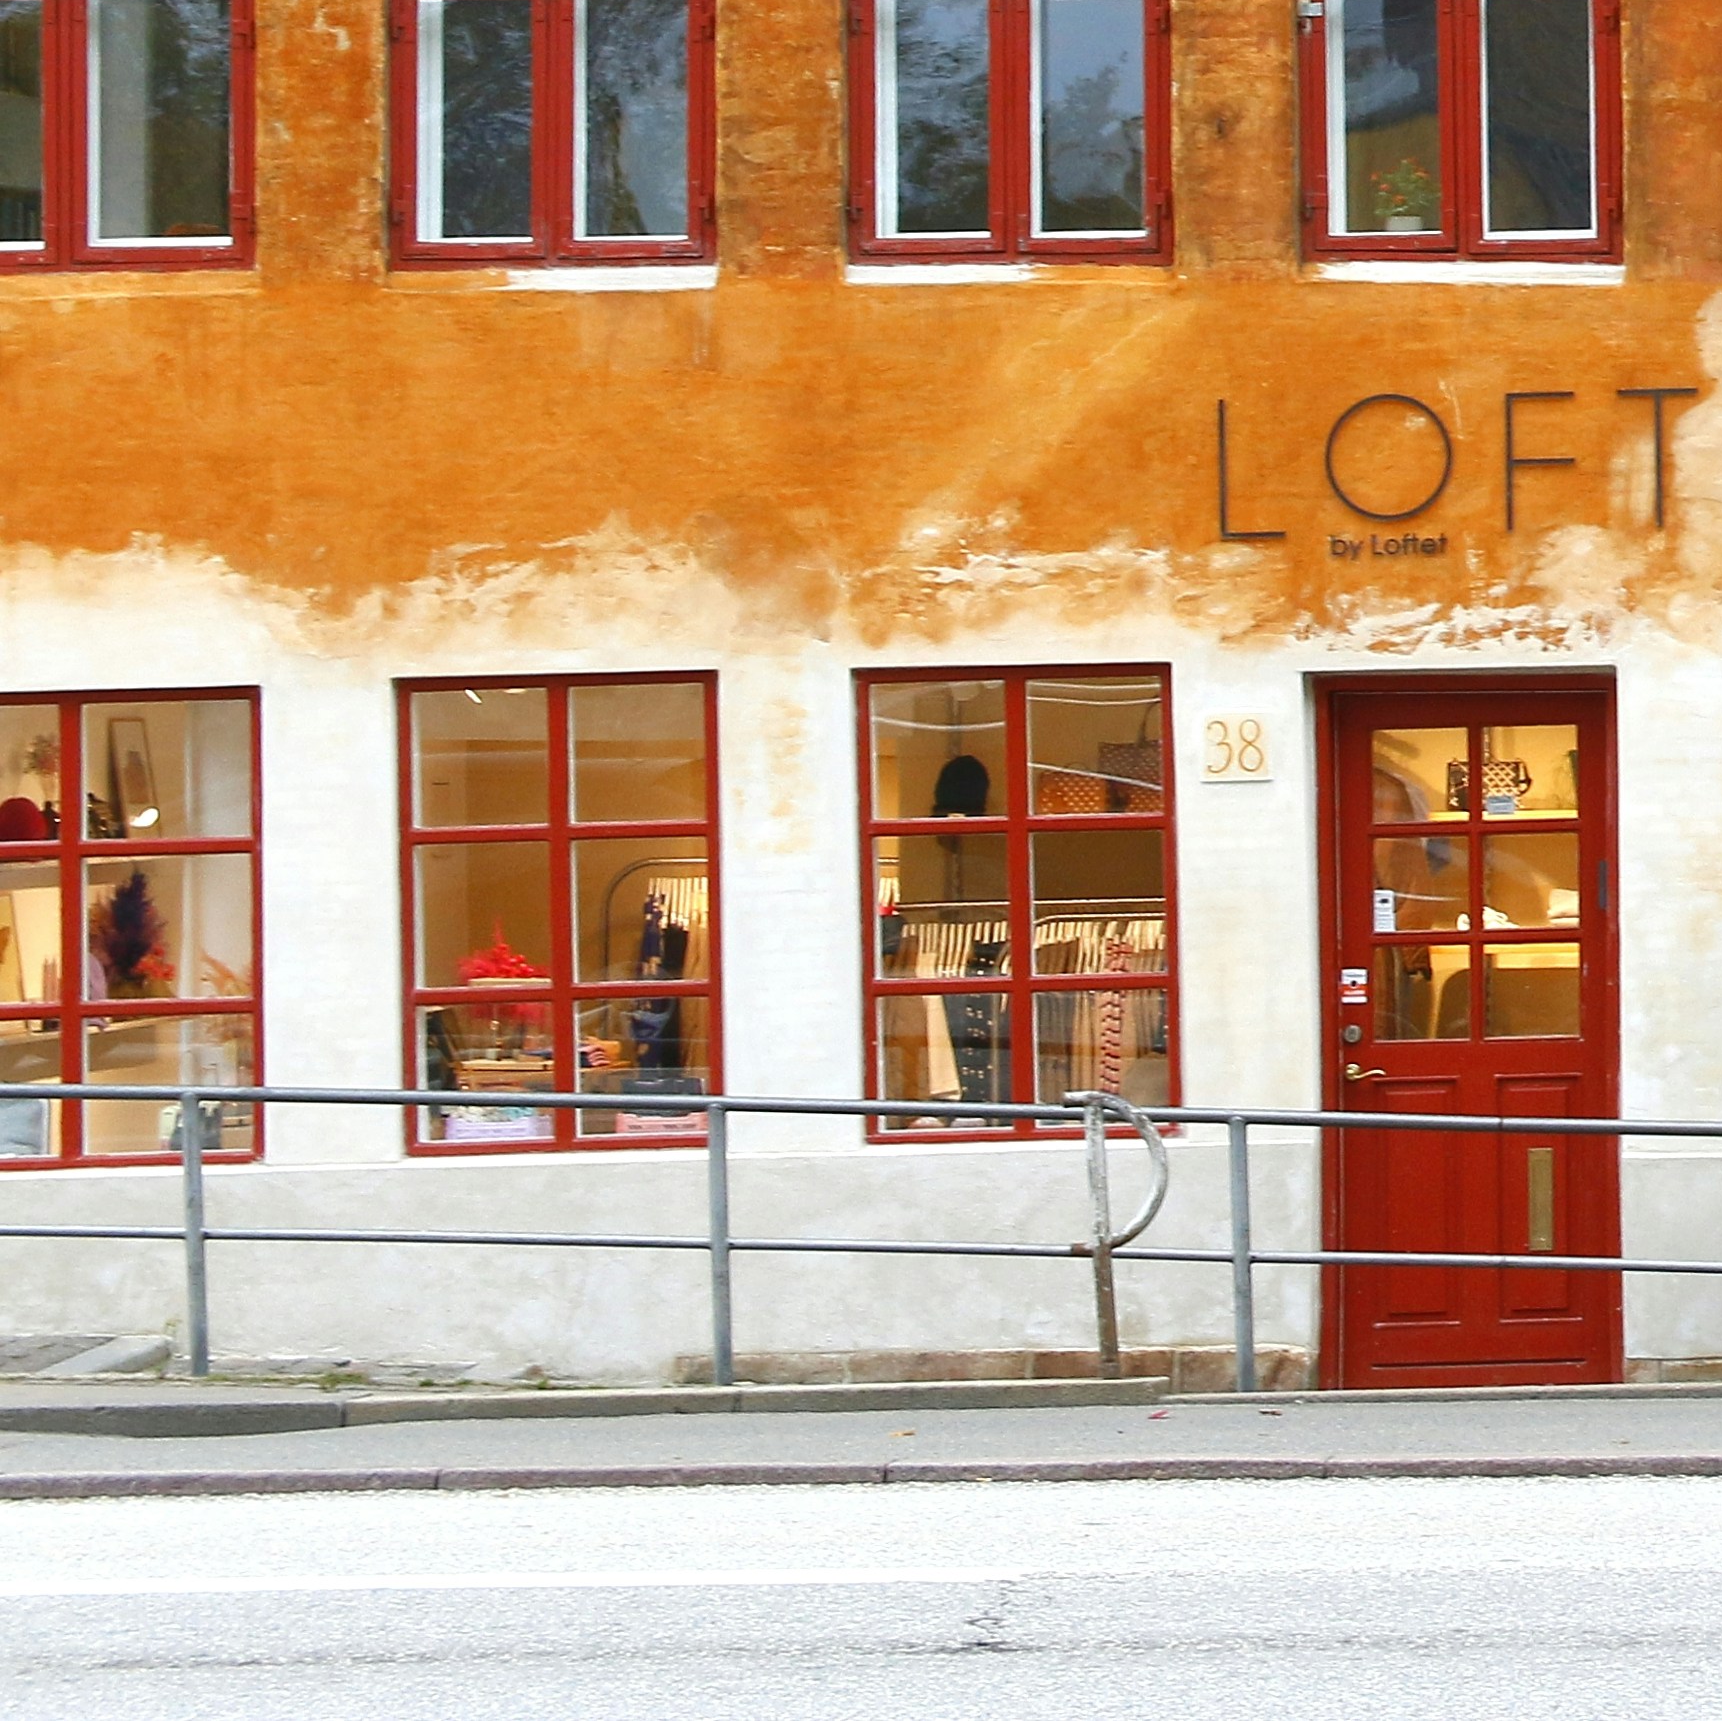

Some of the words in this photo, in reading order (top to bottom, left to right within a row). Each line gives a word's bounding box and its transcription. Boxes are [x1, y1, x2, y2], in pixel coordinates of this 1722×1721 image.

[1216, 387, 1701, 543] LOFT
[1328, 534, 1363, 560] by
[1371, 533, 1448, 556] Loftet
[1206, 719, 1264, 774] 38
